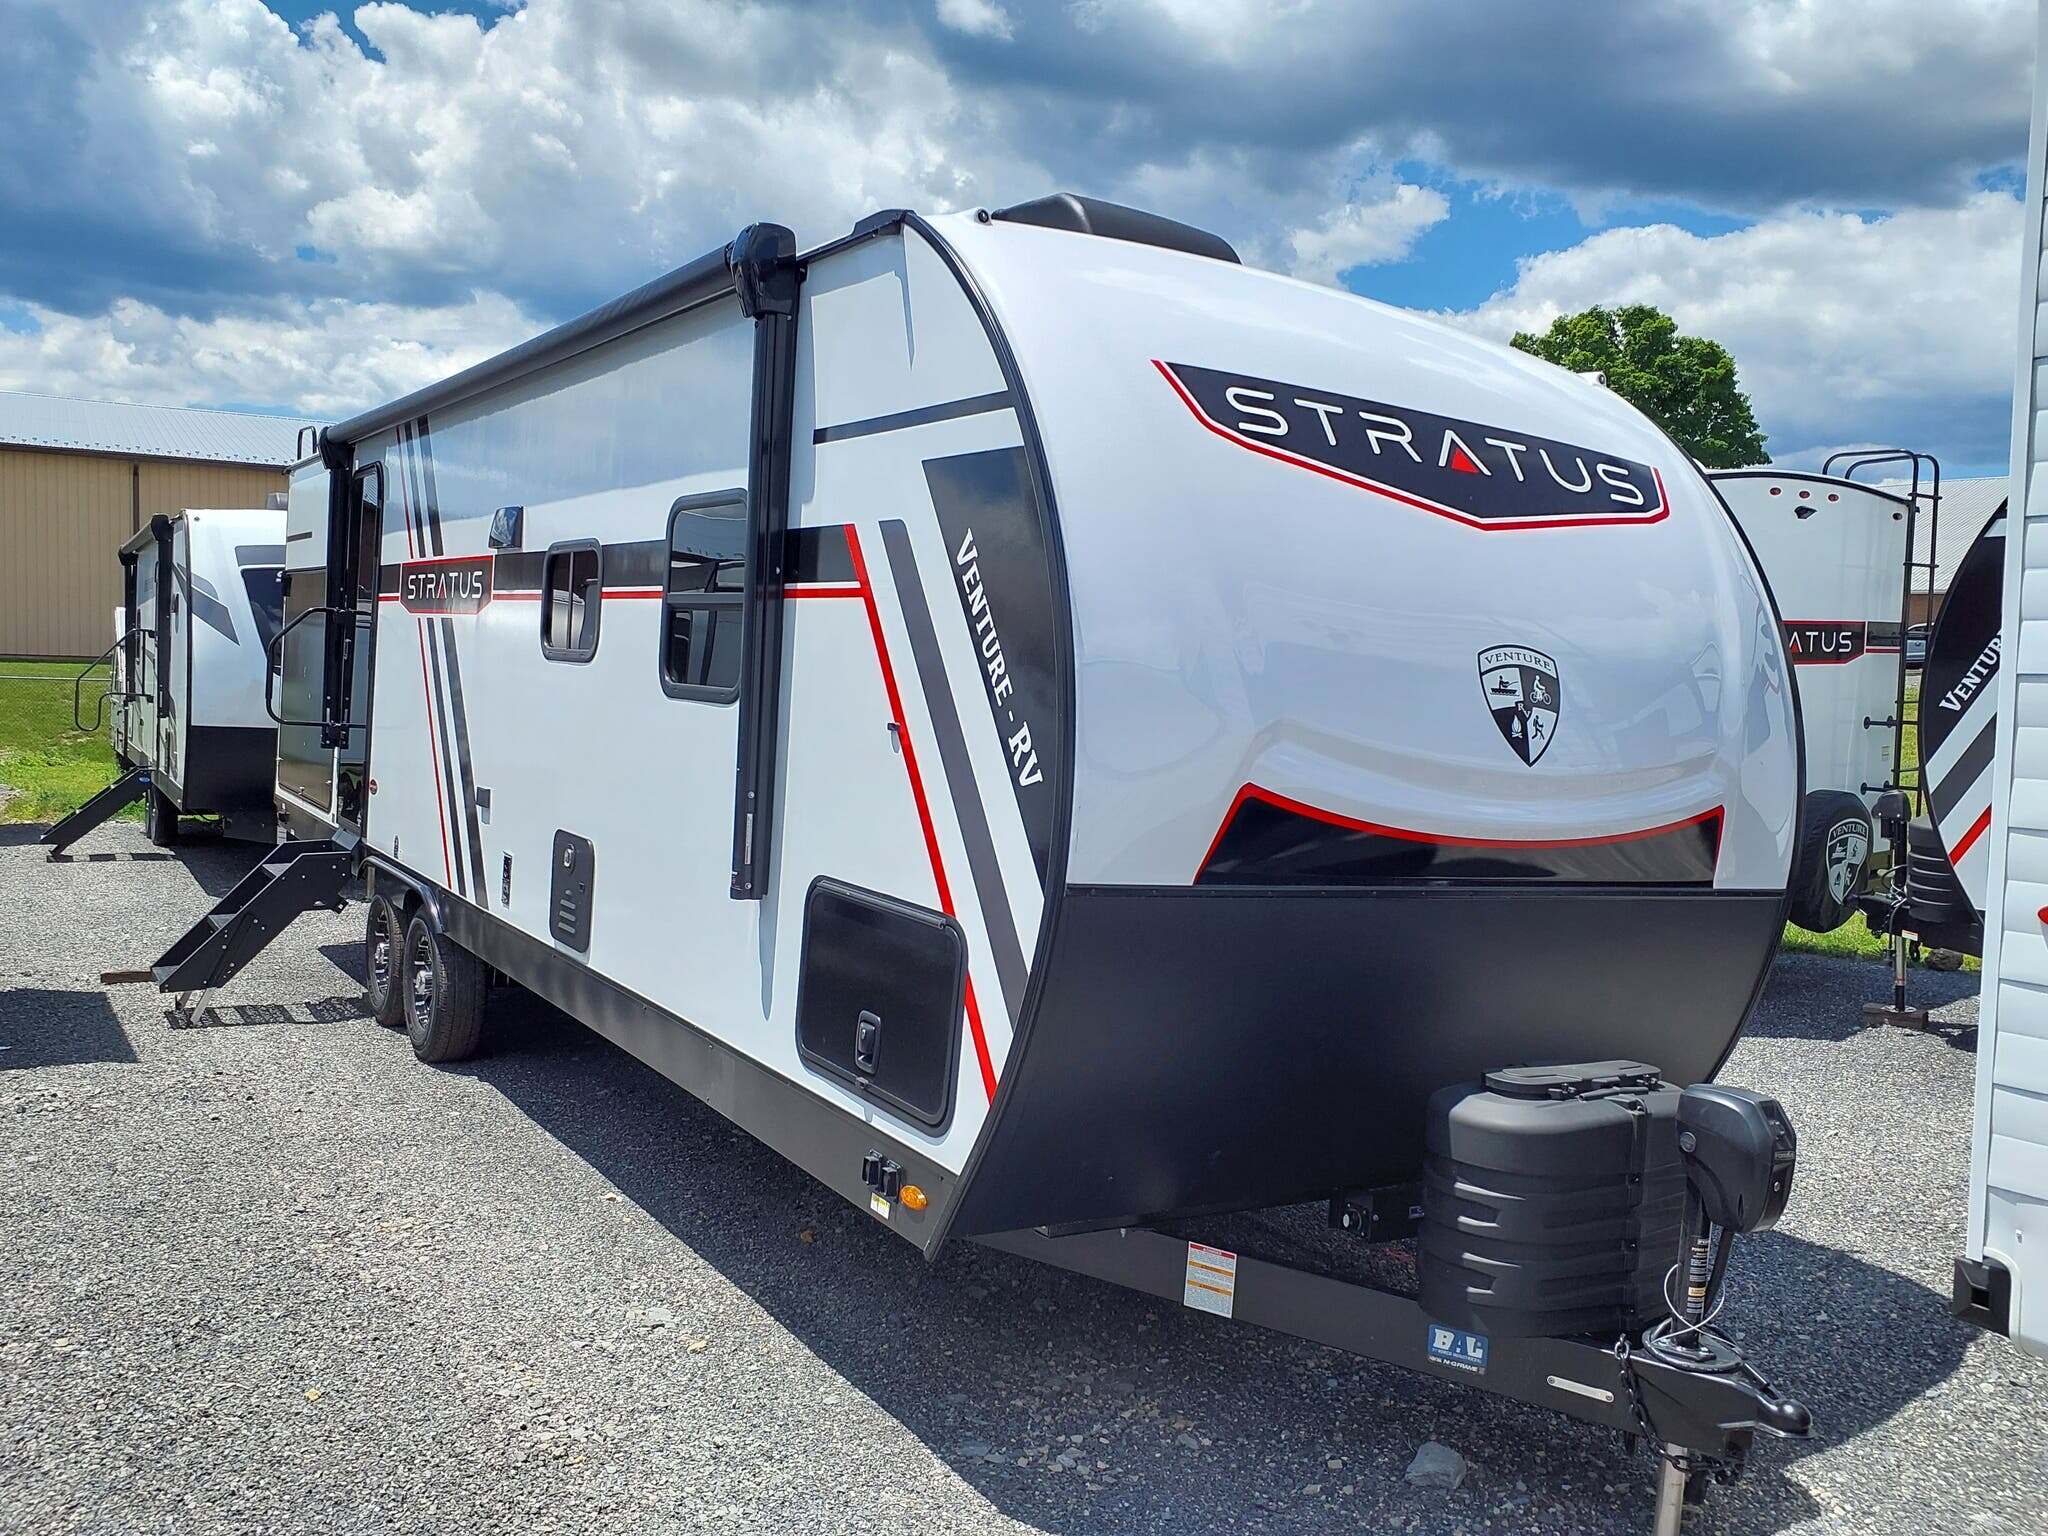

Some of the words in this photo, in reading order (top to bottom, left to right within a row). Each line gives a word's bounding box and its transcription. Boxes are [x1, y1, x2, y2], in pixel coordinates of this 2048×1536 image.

[1225, 386, 1644, 506] STRATUS
[407, 570, 483, 600] STRATUS
[1789, 631, 1852, 653] ATUS
[956, 527, 1015, 707] VENTURE
[1008, 721, 1043, 788] RV
[1484, 651, 1553, 672] VENTURE
[1939, 628, 2002, 712] VENTUR
[1832, 823, 1866, 839] VENTURE
